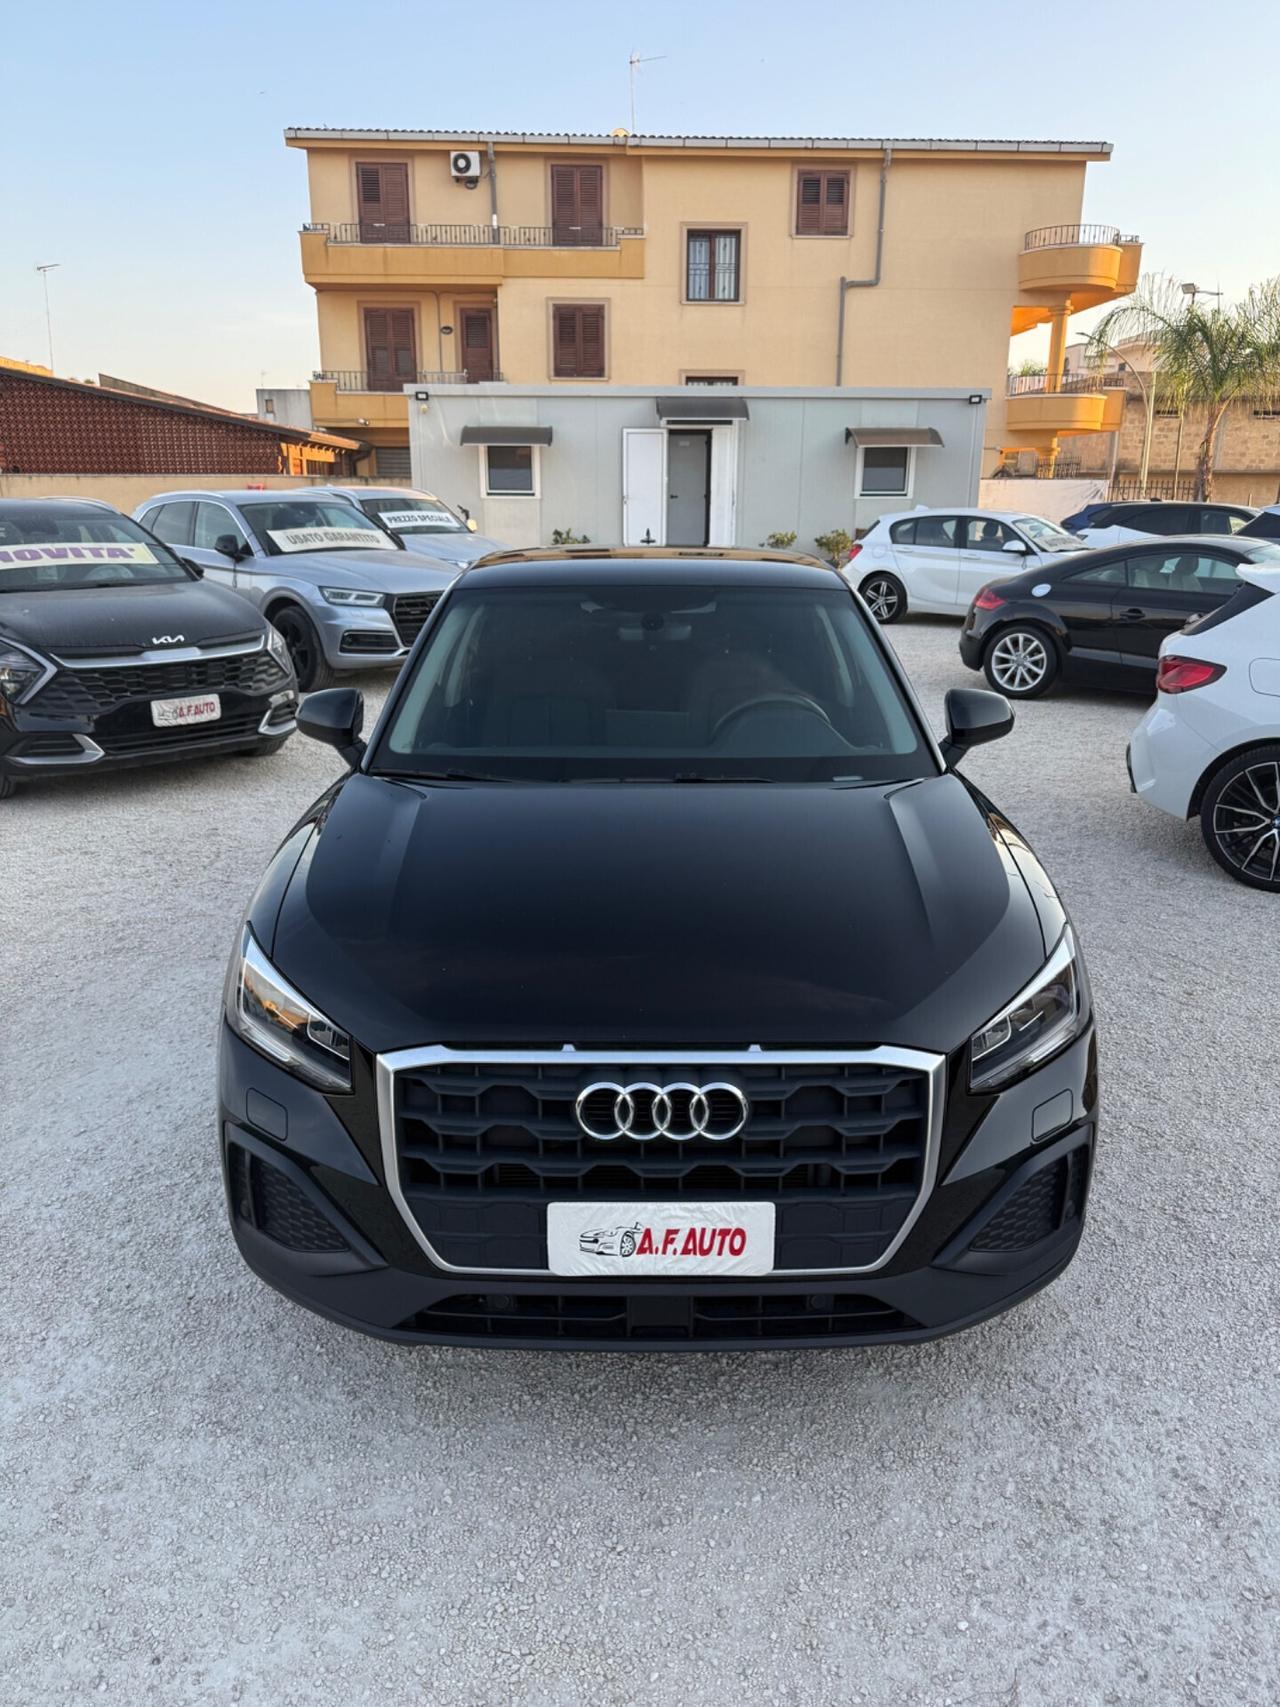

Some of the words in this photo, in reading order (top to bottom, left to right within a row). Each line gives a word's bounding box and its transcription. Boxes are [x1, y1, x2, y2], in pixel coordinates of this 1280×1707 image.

[387, 515, 418, 524] PREZZO
[286, 533, 324, 545] USATO
[323, 532, 381, 544] GARANTITO
